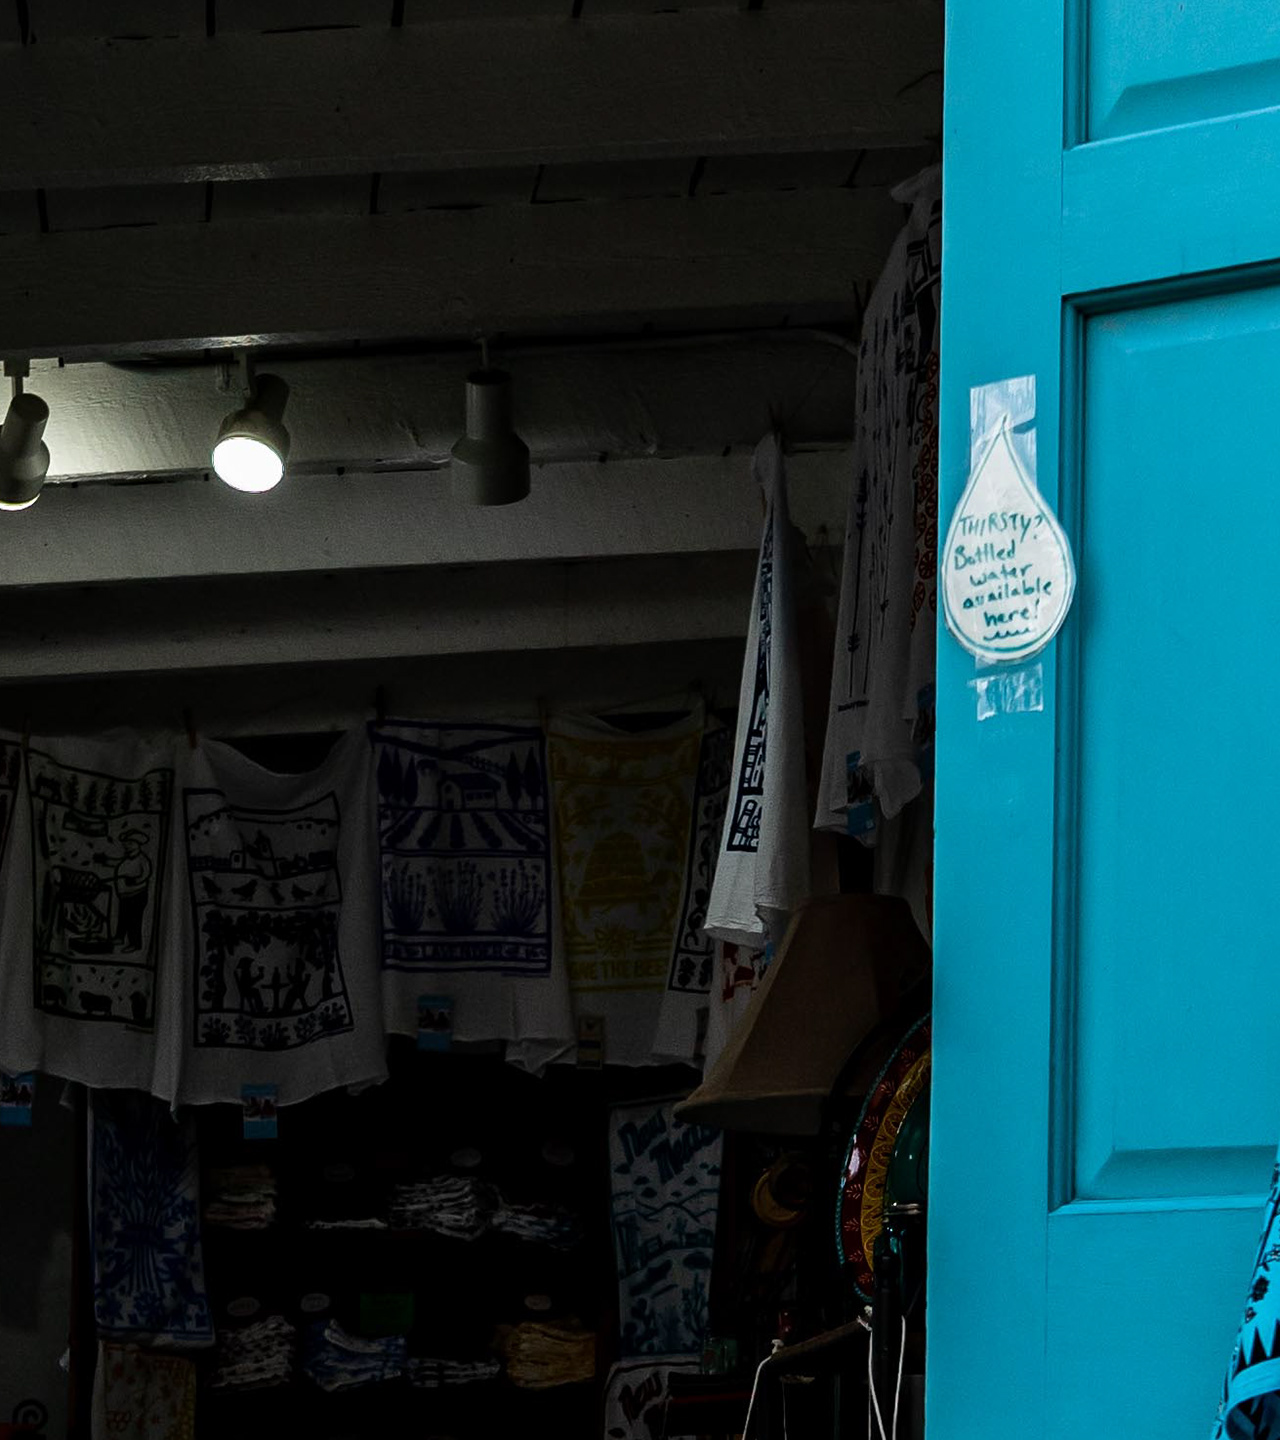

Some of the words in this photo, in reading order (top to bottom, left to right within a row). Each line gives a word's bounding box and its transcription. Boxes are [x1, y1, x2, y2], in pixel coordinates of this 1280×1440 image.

[960, 512, 1043, 543] THIRSTY?
[954, 539, 1016, 570] Bottled
[969, 563, 1033, 587] water
[962, 576, 1052, 609] available
[983, 598, 1040, 627] here!
